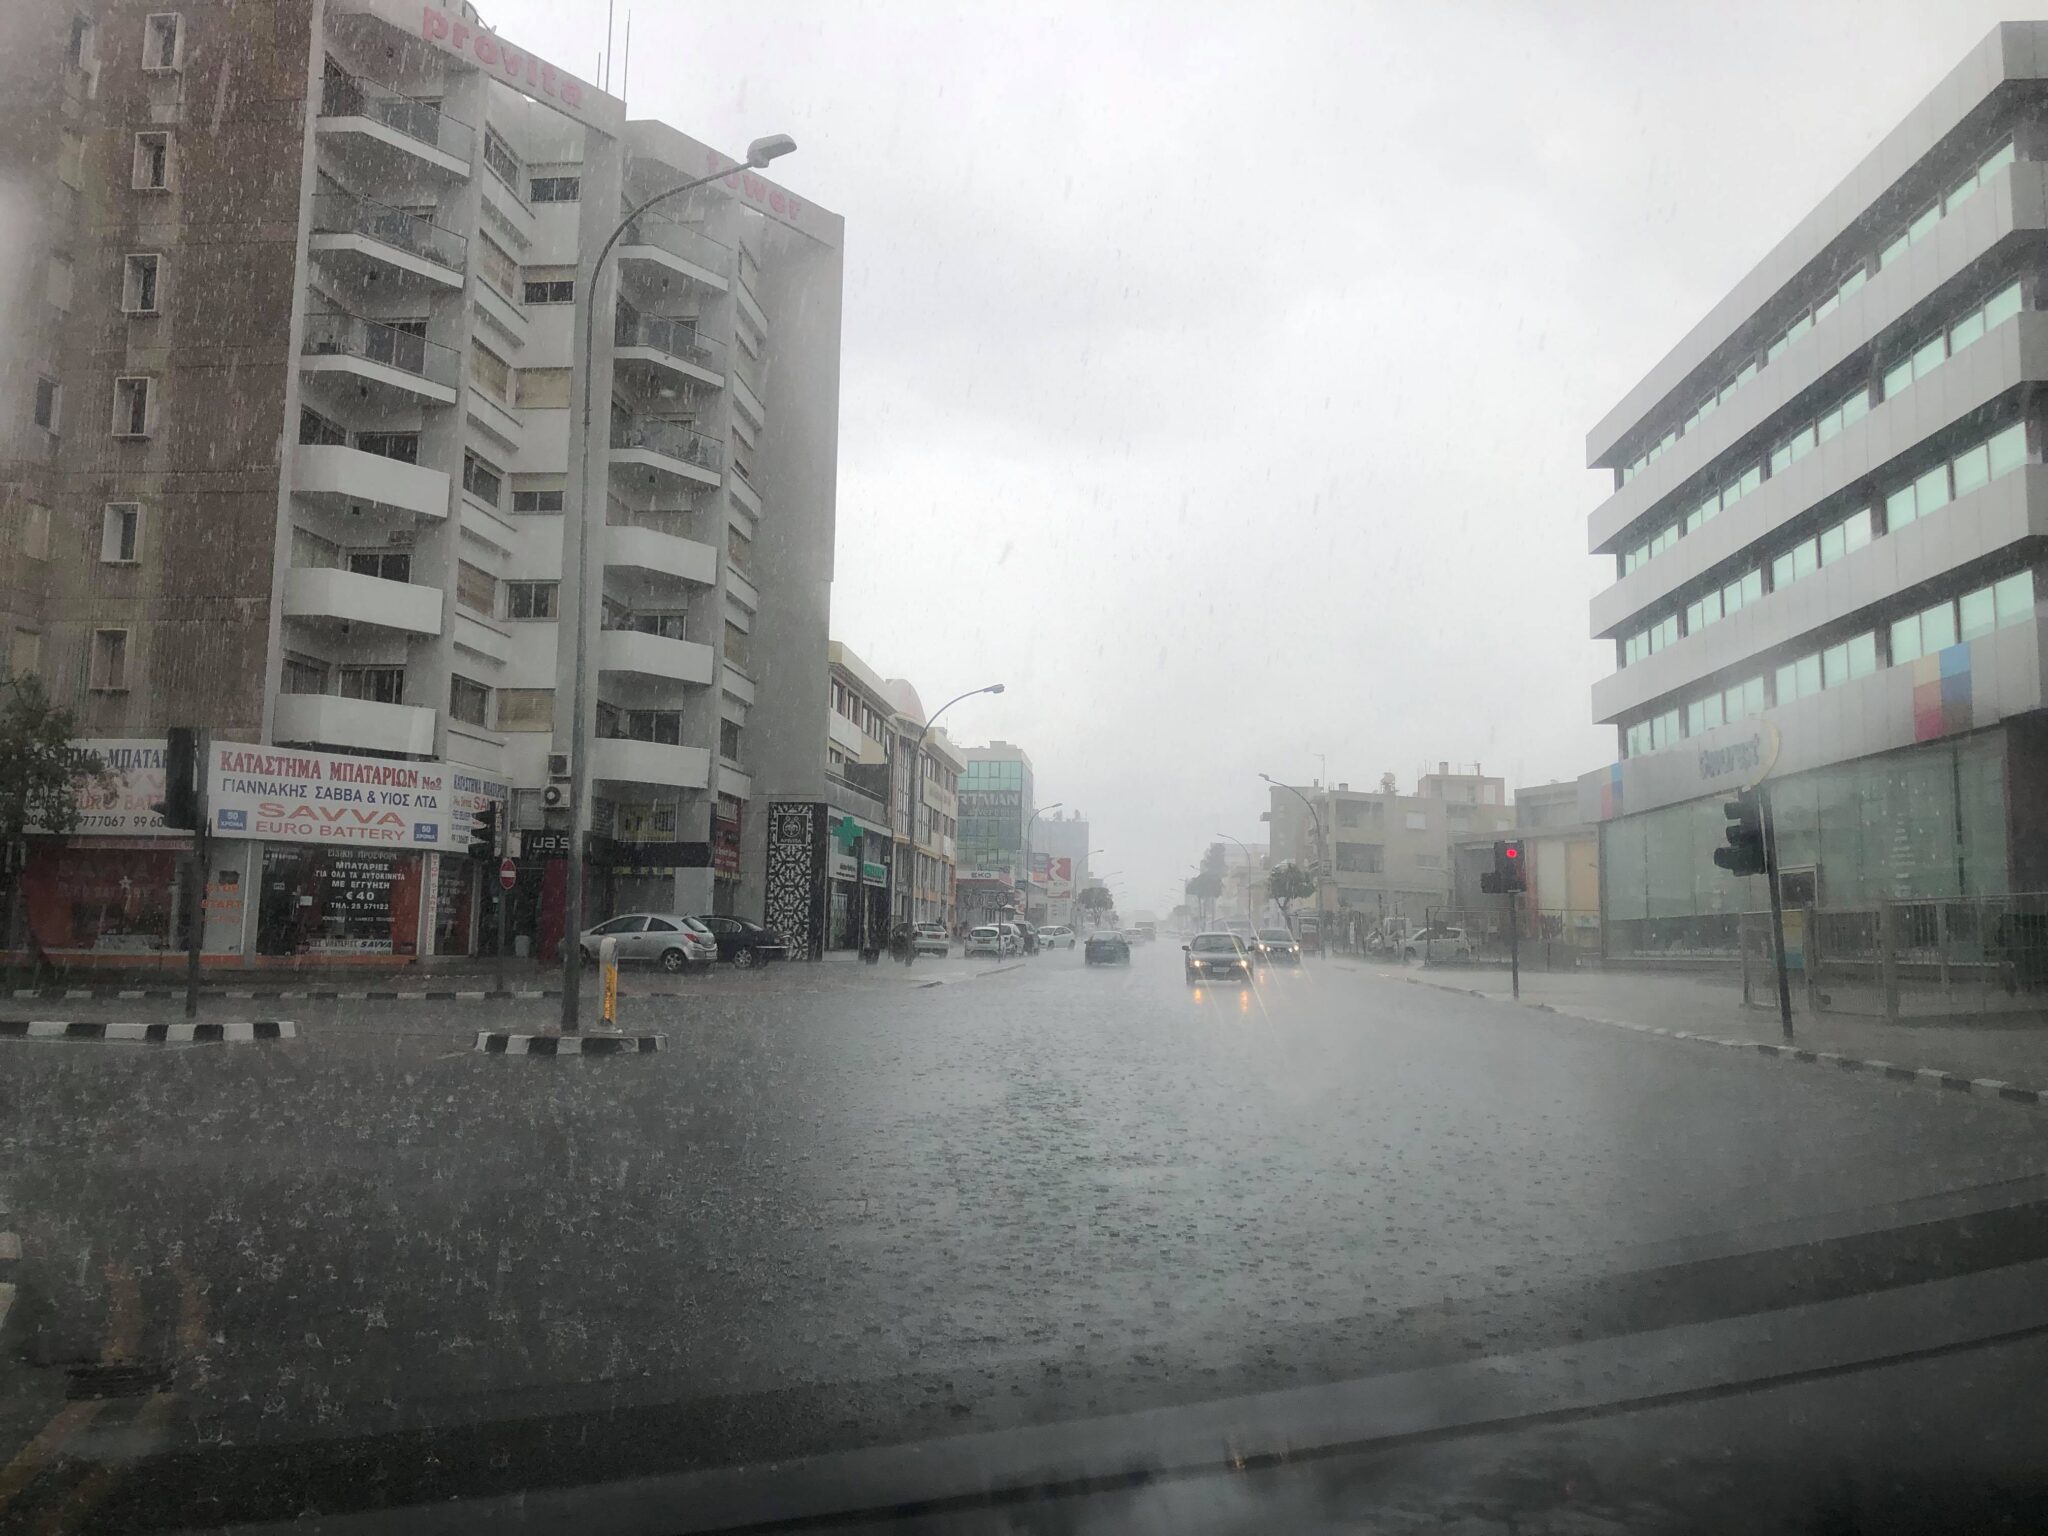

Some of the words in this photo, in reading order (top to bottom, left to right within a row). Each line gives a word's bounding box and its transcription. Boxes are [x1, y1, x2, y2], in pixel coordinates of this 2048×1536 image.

[421, 6, 583, 108] provita
[220, 751, 322, 780] ΚΑΤΑΣΤΗΜΑ
[329, 762, 419, 788] ΜΠΑΤΑΡΙΩΝ
[222, 778, 308, 798] ΓΙΑΝΝΑΚΗΣ
[315, 786, 363, 803] ΣΑΒΒΑ
[367, 791, 376, 803] &
[380, 792, 410, 807] ΥΙΟΣ
[414, 795, 437, 808] ΛΤΔ
[257, 802, 406, 826] SAVVA
[256, 820, 313, 835] EURO
[319, 825, 406, 841] BATTERY
[335, 861, 389, 871] ΜΠΑΤΑΡΙΕΣ
[361, 872, 406, 881] ΑΥΤΟΚΙΝΗΤΑ
[331, 880, 345, 888] ΜΕ
[350, 881, 390, 889] ΕΓΓΥΗΣΗ
[359, 940, 392, 948] SAVVA
